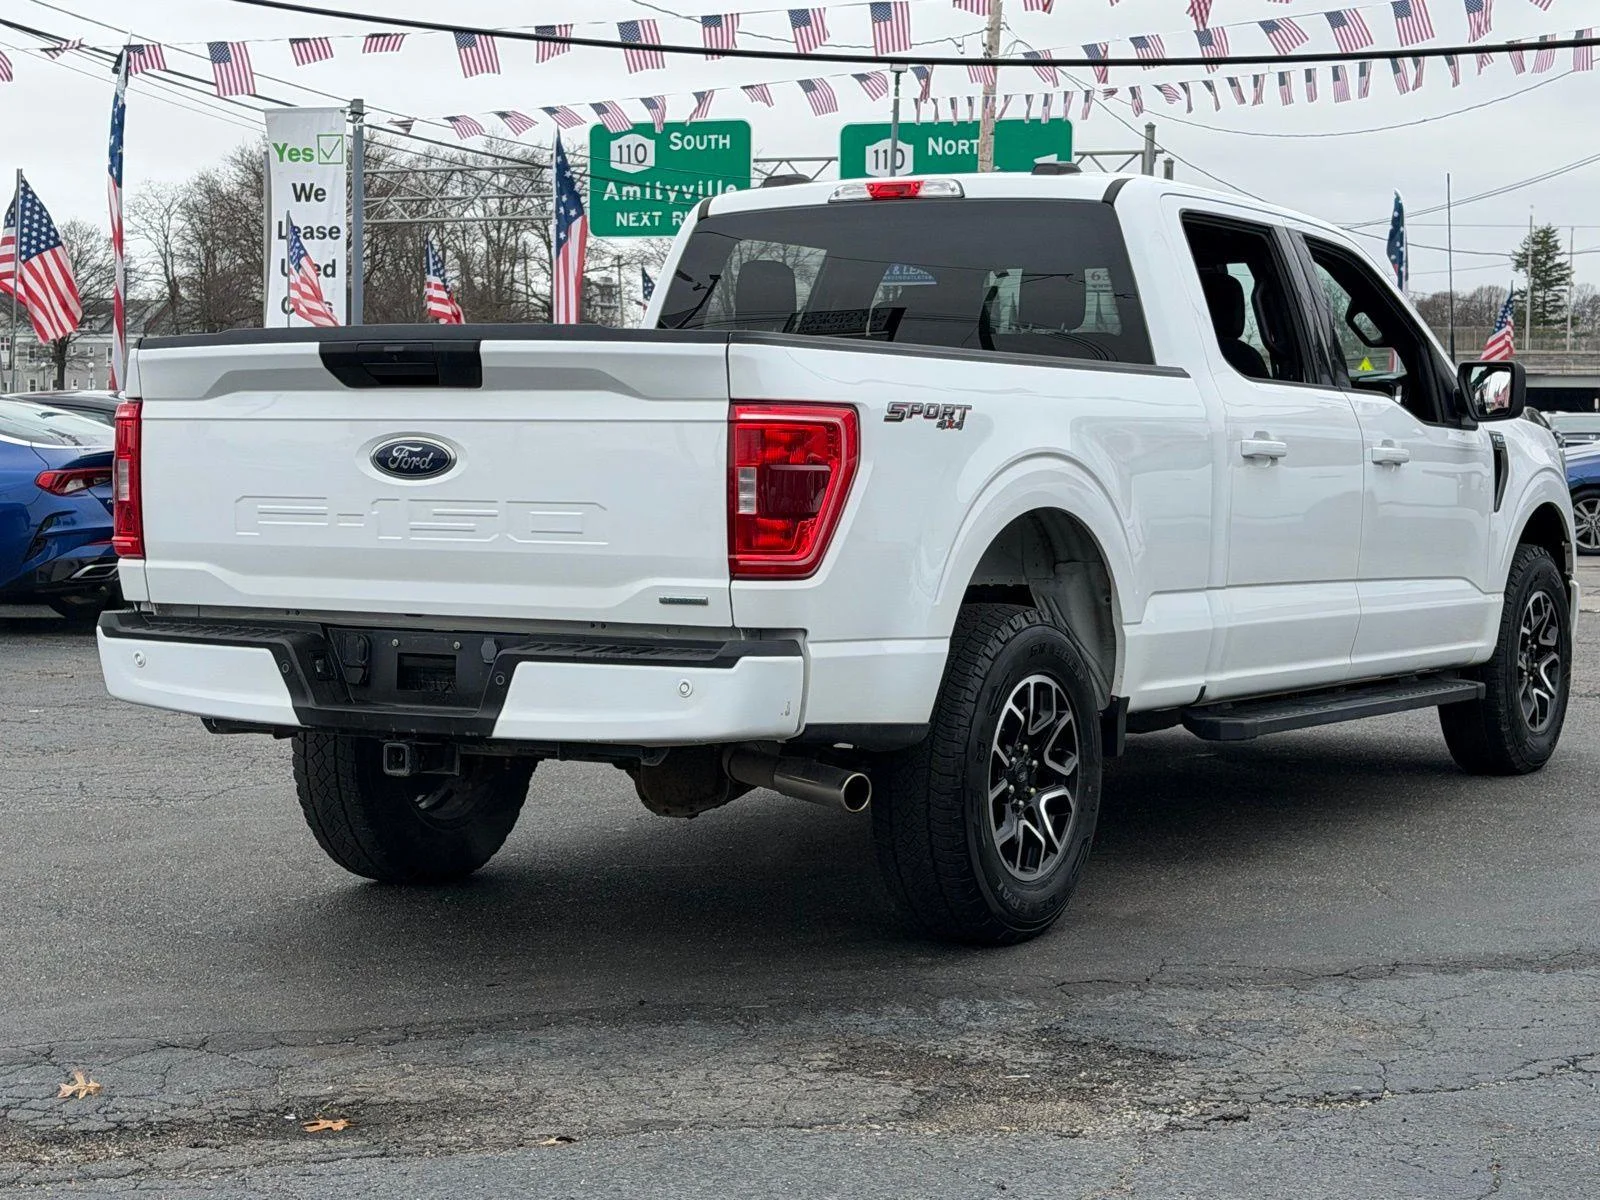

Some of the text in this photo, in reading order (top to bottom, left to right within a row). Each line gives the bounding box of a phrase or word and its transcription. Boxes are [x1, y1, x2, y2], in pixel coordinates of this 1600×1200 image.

[271, 142, 315, 163] Yes
[617, 143, 648, 164] 110
[927, 136, 980, 156] NORT
[291, 182, 327, 203] We
[603, 180, 737, 204] Amityville
[615, 211, 662, 227] NEXT
[883, 401, 973, 423] SPORT
[387, 444, 434, 470] Ford
[234, 495, 609, 547] F-150
